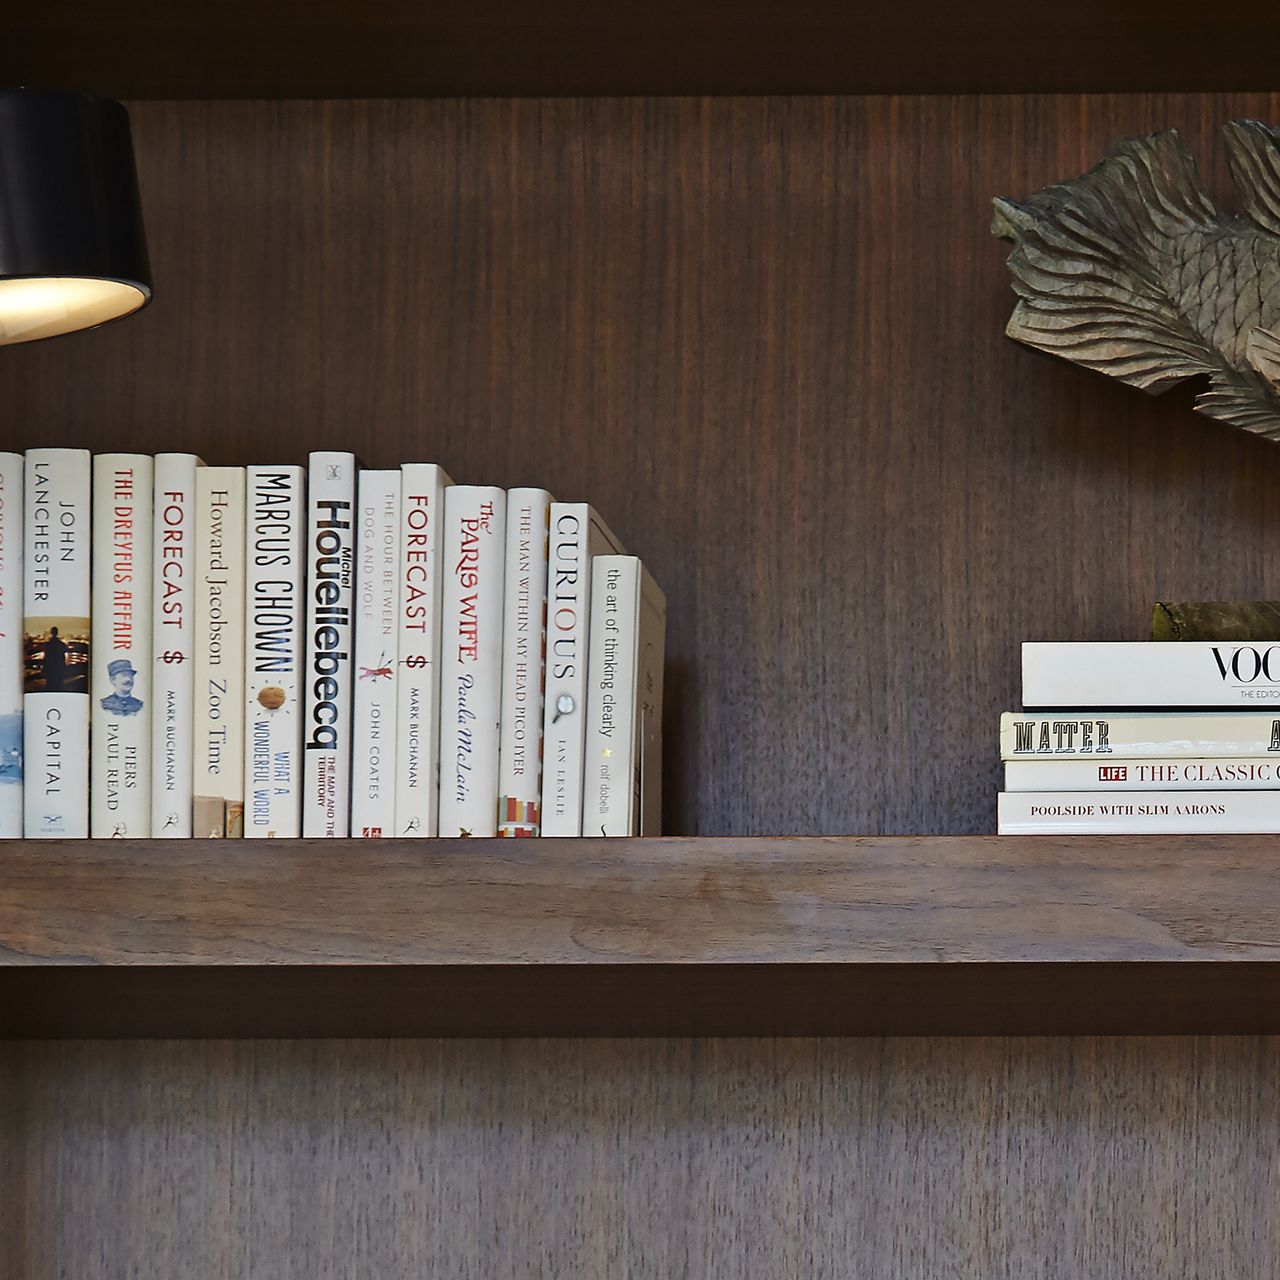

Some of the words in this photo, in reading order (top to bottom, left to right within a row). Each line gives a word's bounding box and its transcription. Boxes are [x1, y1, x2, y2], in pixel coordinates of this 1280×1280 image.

[114, 469, 133, 499] THE
[34, 463, 49, 601] LANCHESTER
[59, 501, 75, 561] JOHN
[114, 507, 133, 583] DREYFUS
[210, 491, 229, 570] Howard
[255, 474, 291, 566] MARCUS
[163, 492, 184, 629] FORECAST
[406, 496, 428, 633] FORECAST
[455, 518, 479, 588] PARIS
[607, 569, 621, 590] the
[113, 591, 132, 649] AFFAIR
[205, 576, 228, 665] Jacobson
[254, 581, 293, 672] CHOWN
[306, 500, 349, 751] Houellebecq
[554, 515, 579, 679] CURIOUS
[605, 619, 619, 633] of
[606, 595, 617, 613] art
[458, 593, 478, 664] WIFE
[600, 638, 619, 689] thinking
[166, 690, 175, 722] MARK
[209, 680, 226, 720] Zoo
[598, 694, 616, 737] clearly
[1241, 690, 1254, 699] THE
[46, 708, 61, 795] CAPITAL
[166, 726, 175, 790] BUCHANAN
[208, 725, 226, 774] Time
[1013, 721, 1113, 754] MATTER
[1099, 766, 1127, 781] LIFE
[1136, 765, 1178, 781] THE
[1184, 765, 1270, 781] CLASSIC
[1031, 806, 1094, 816] POOLSIDE
[1100, 805, 1133, 815] WITH
[1138, 805, 1168, 815] SLIM
[1176, 805, 1225, 815] AARONS
